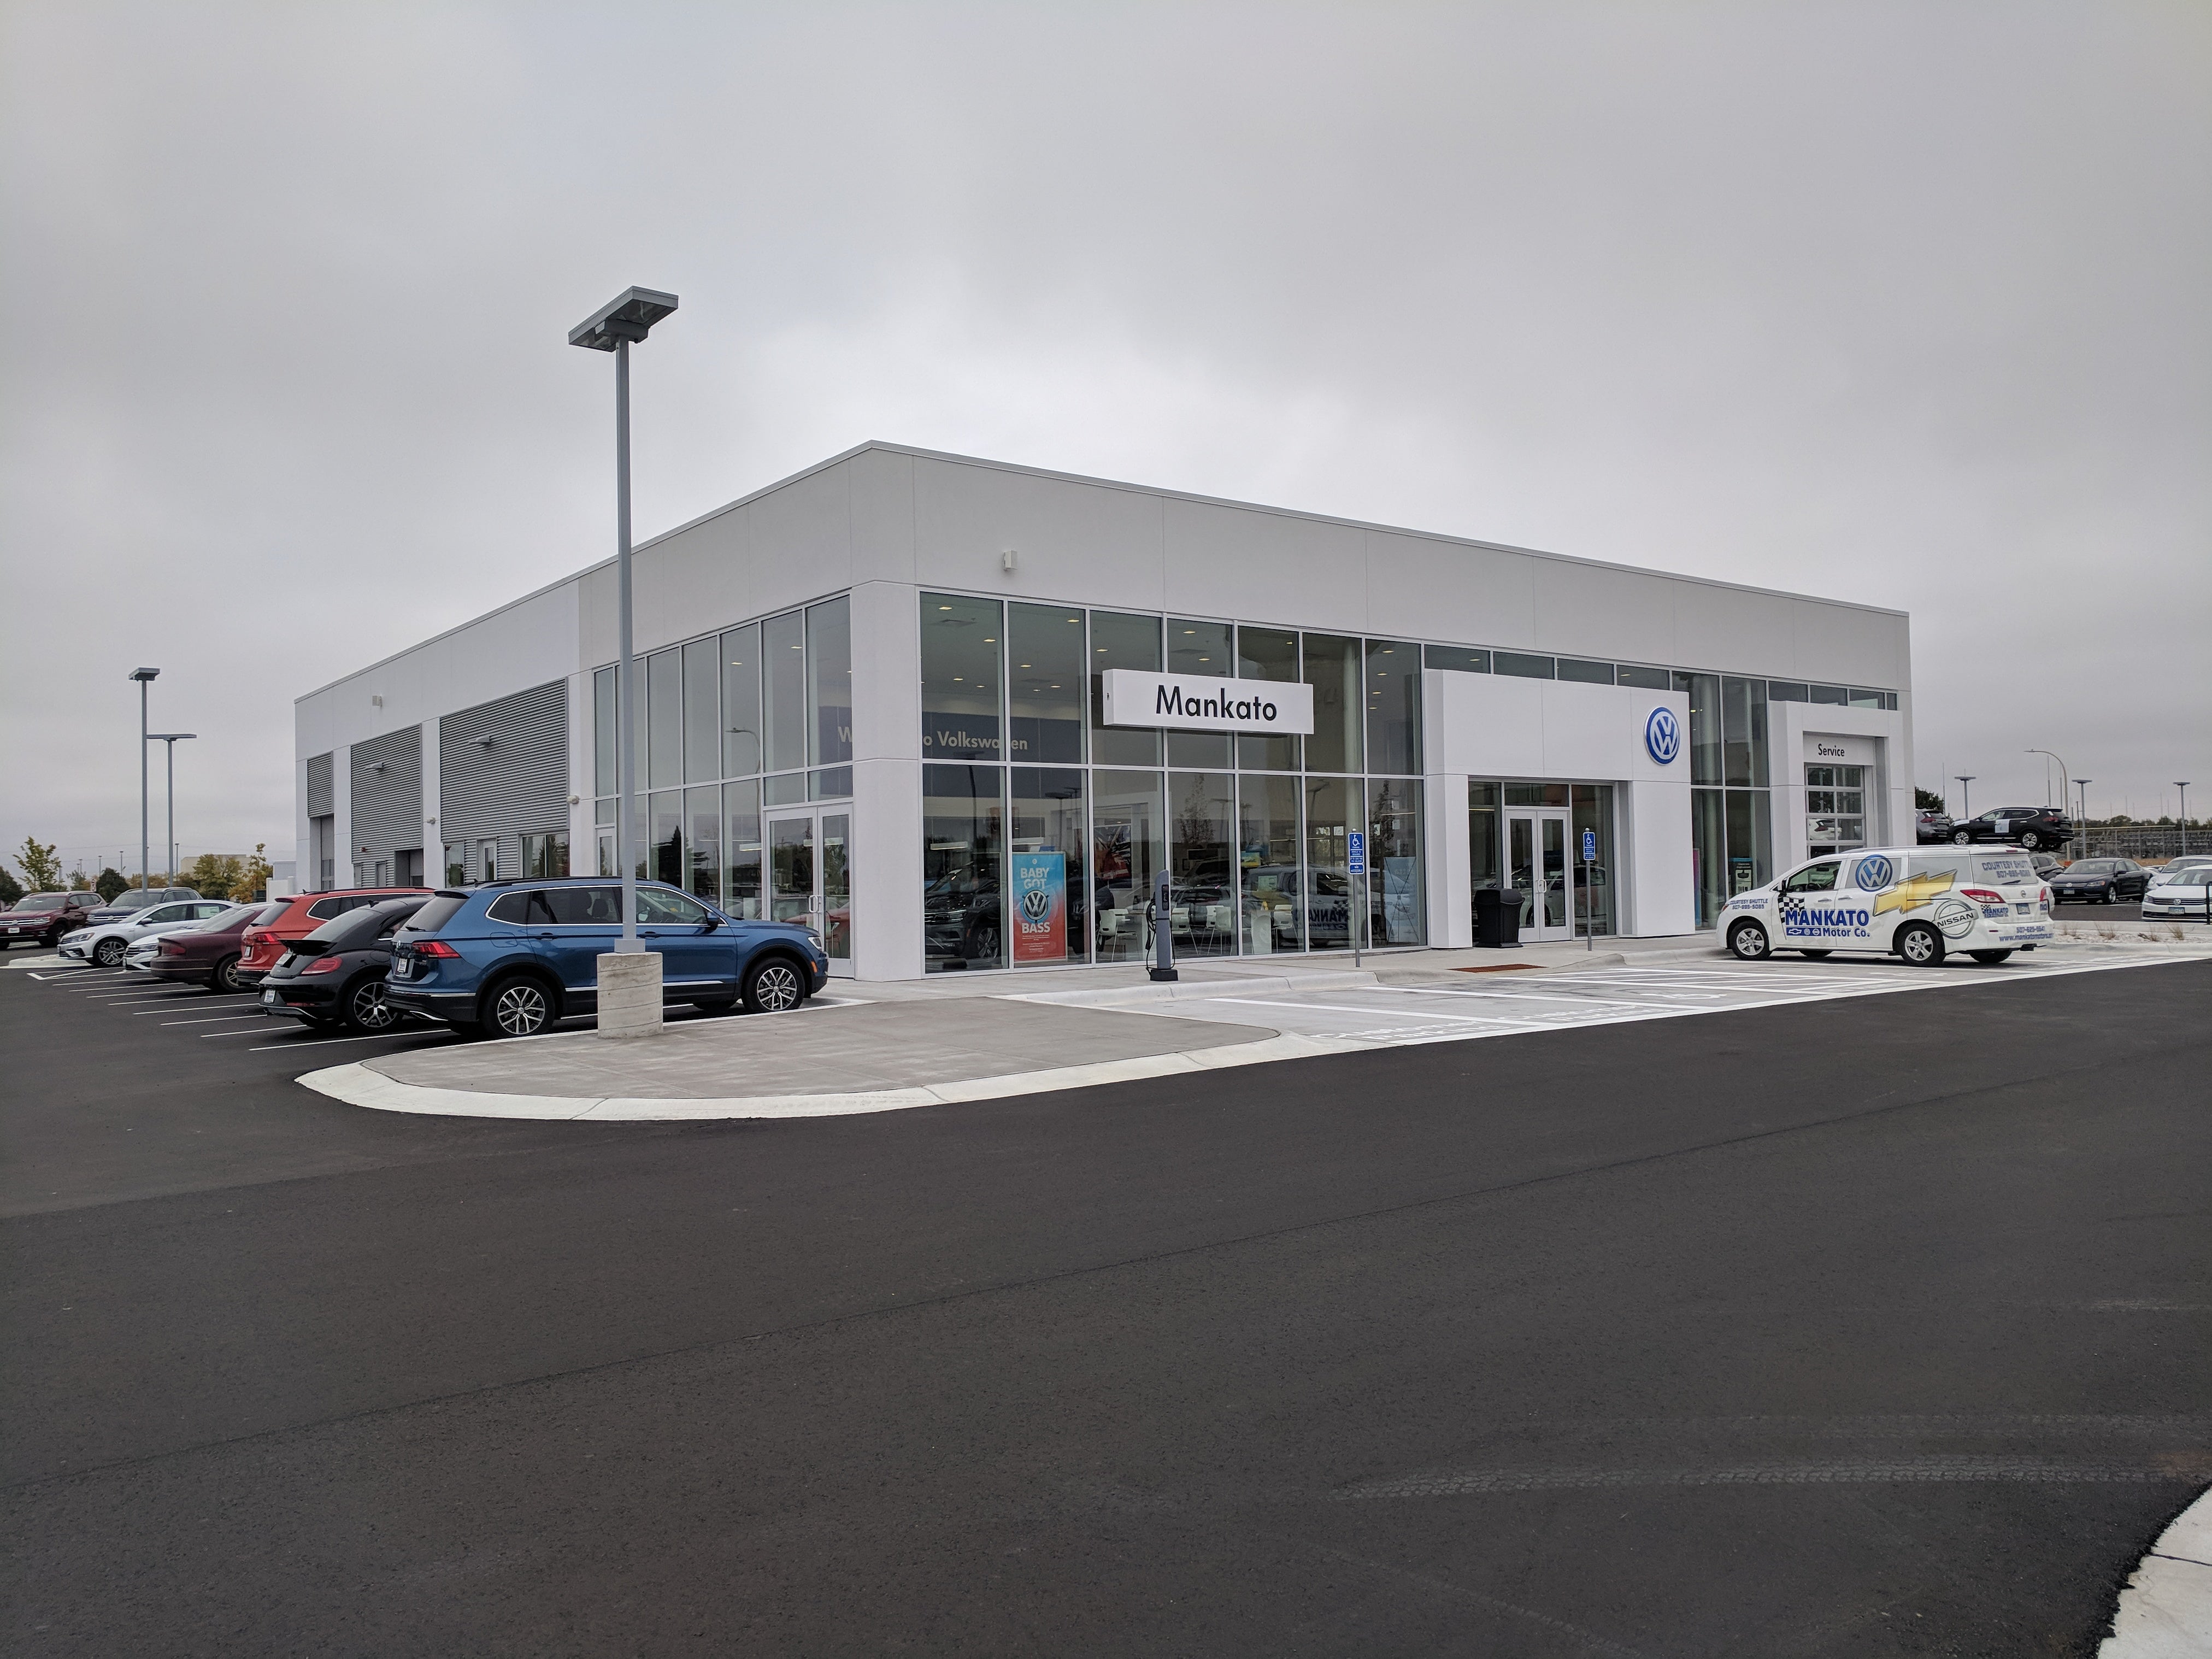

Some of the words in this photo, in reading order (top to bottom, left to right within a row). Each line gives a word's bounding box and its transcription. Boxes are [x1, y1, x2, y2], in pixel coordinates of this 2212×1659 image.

[1156, 684, 1277, 721] Mankato
[937, 731, 1028, 750] Volkswaen
[1817, 743, 1845, 757] Service
[1982, 861, 2013, 871] COURTESY
[2013, 860, 2032, 868] SHUTT
[1020, 867, 1050, 879] BABY
[1023, 878, 1047, 890] GOT
[1785, 910, 1869, 927] MANKATO
[1937, 913, 1974, 928] NISSAN
[1021, 922, 1050, 934] BASS
[1823, 928, 1851, 937] Motor
[1854, 927, 1870, 937] Co.
[1362, 1025, 1511, 1040] Parking
